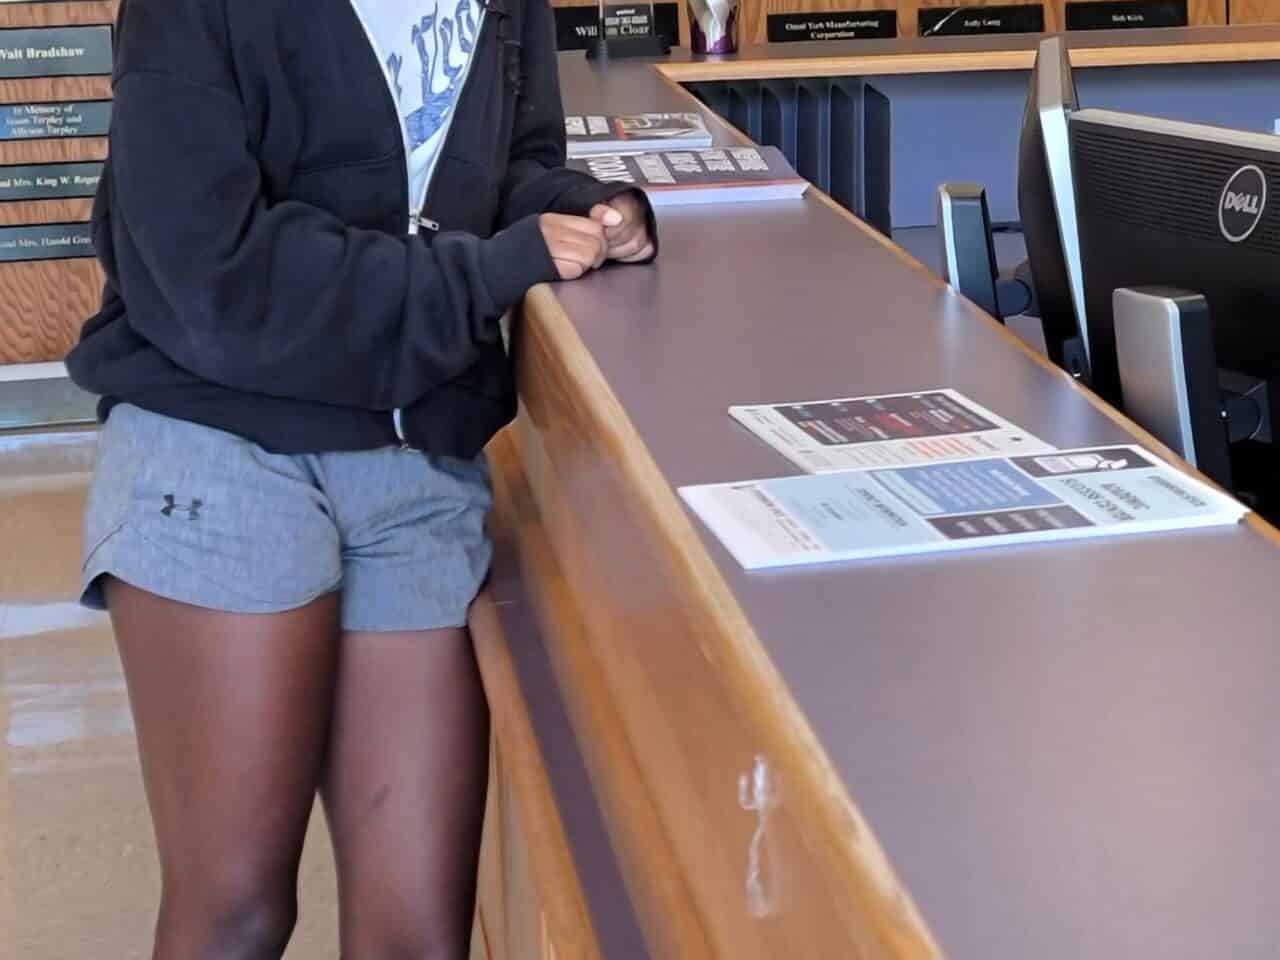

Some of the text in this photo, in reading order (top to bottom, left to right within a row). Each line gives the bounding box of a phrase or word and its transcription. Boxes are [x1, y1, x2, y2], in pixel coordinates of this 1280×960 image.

[576, 25, 618, 36] Willam
[26, 46, 85, 59] Bradshaw
[1224, 191, 1258, 215] DELL
